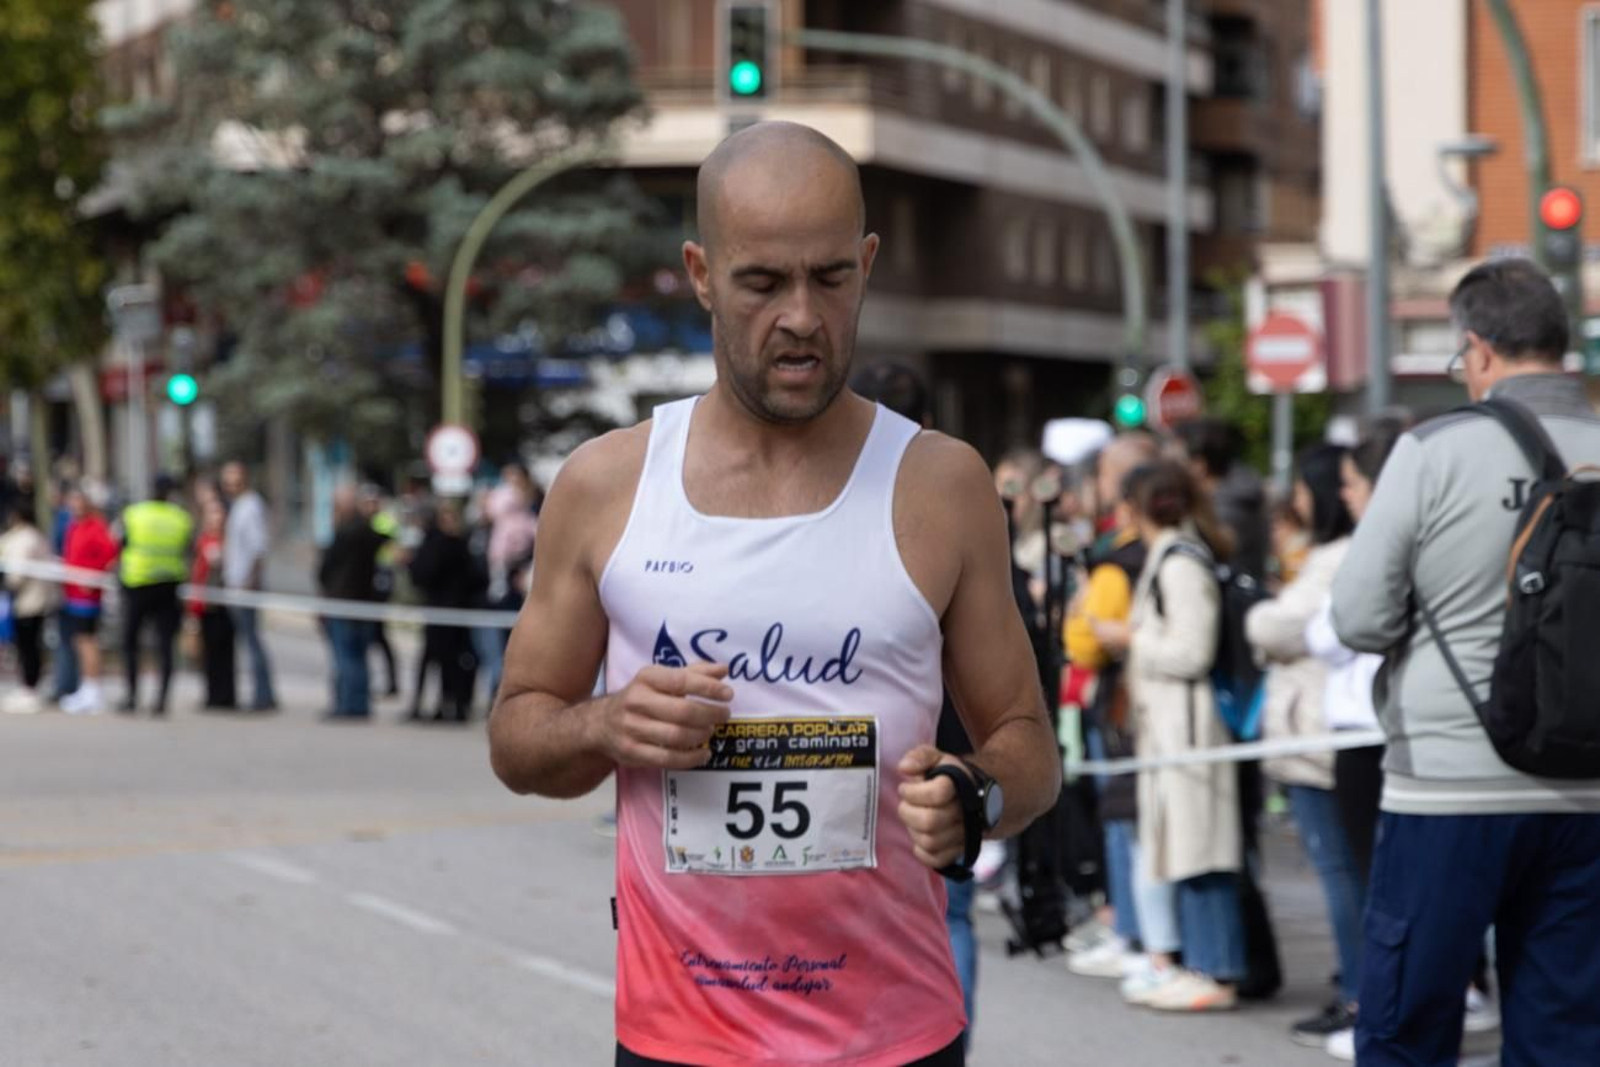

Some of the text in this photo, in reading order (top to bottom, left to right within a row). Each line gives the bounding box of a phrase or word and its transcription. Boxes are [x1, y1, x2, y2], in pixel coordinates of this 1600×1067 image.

[716, 723, 868, 738] CARRERA POPULAR
[736, 738, 778, 753] gran
[788, 735, 869, 749] caminata
[726, 781, 810, 840] 55
[782, 953, 847, 973] Personal
